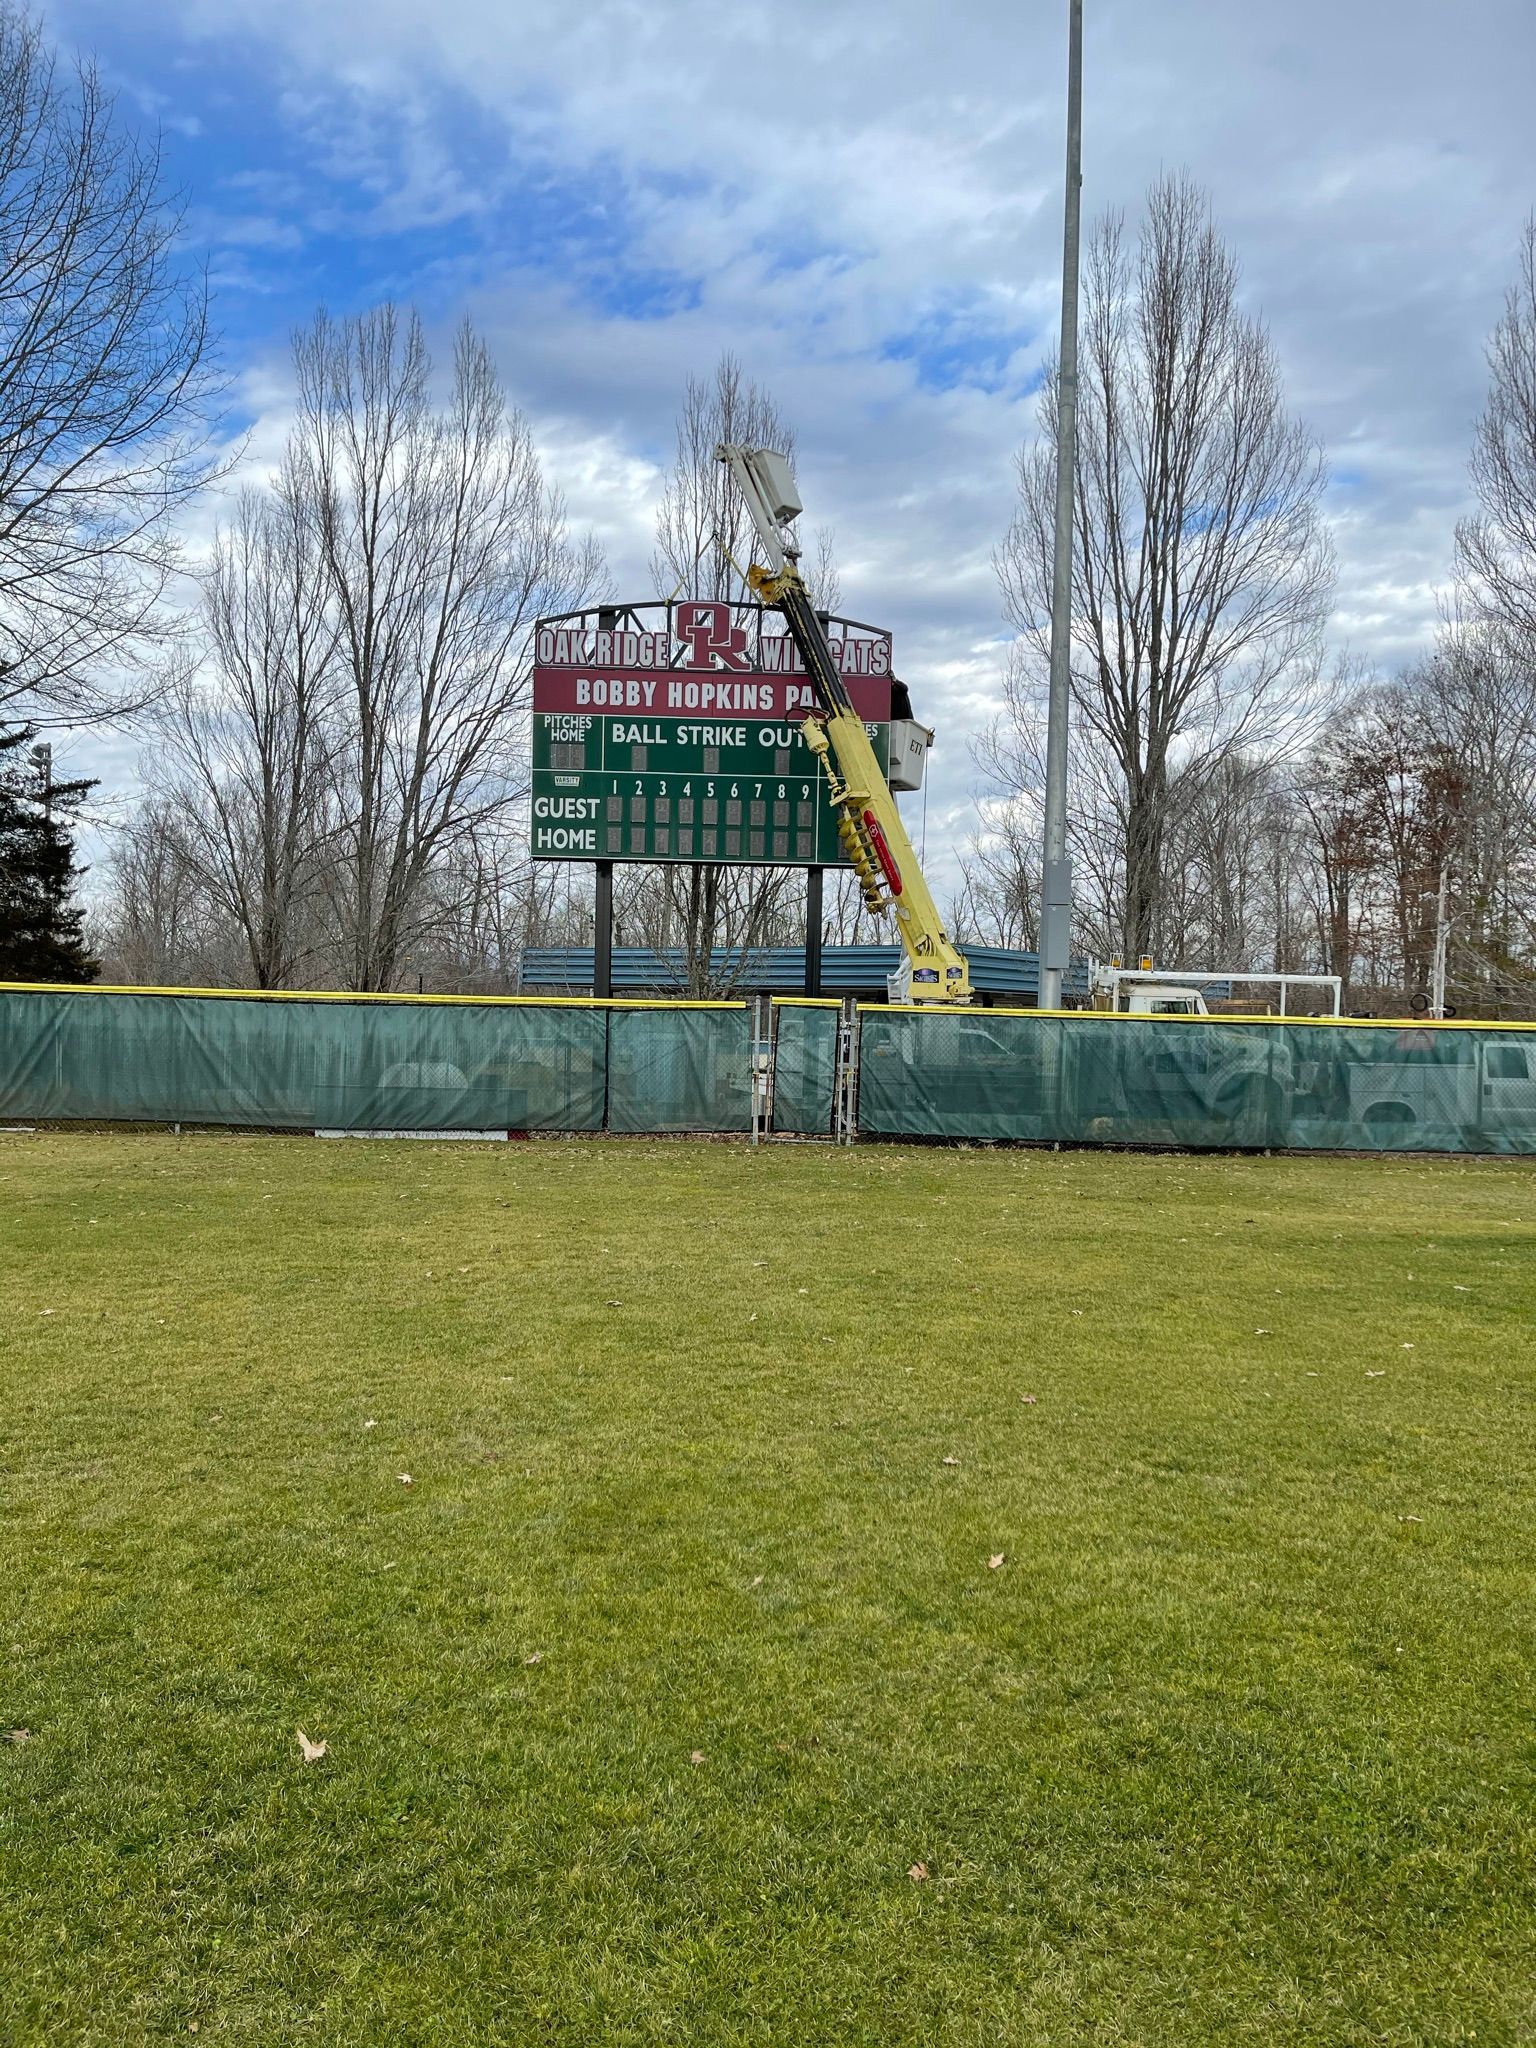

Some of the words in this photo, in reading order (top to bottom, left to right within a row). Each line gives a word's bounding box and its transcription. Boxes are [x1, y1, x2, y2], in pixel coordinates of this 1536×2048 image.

[538, 628, 588, 665] OAK
[596, 630, 669, 669] RIDGE
[760, 636, 890, 676] WILCATS
[576, 678, 656, 707] BOBBY
[668, 682, 774, 710] HOPKINS
[544, 715, 592, 729] PITCHES
[551, 729, 585, 742] HOME
[612, 723, 668, 744] BALL
[676, 726, 747, 746] STRIKE
[613, 779, 617, 794] 1
[635, 780, 643, 795] 2
[659, 781, 667, 795] 3
[683, 781, 691, 797] 4
[707, 782, 715, 797] 5
[730, 783, 738, 798] 6
[754, 783, 762, 798] 7
[778, 784, 786, 799] 8
[802, 785, 810, 800] 9
[534, 797, 600, 819] GUEST
[537, 828, 596, 850] HOME
